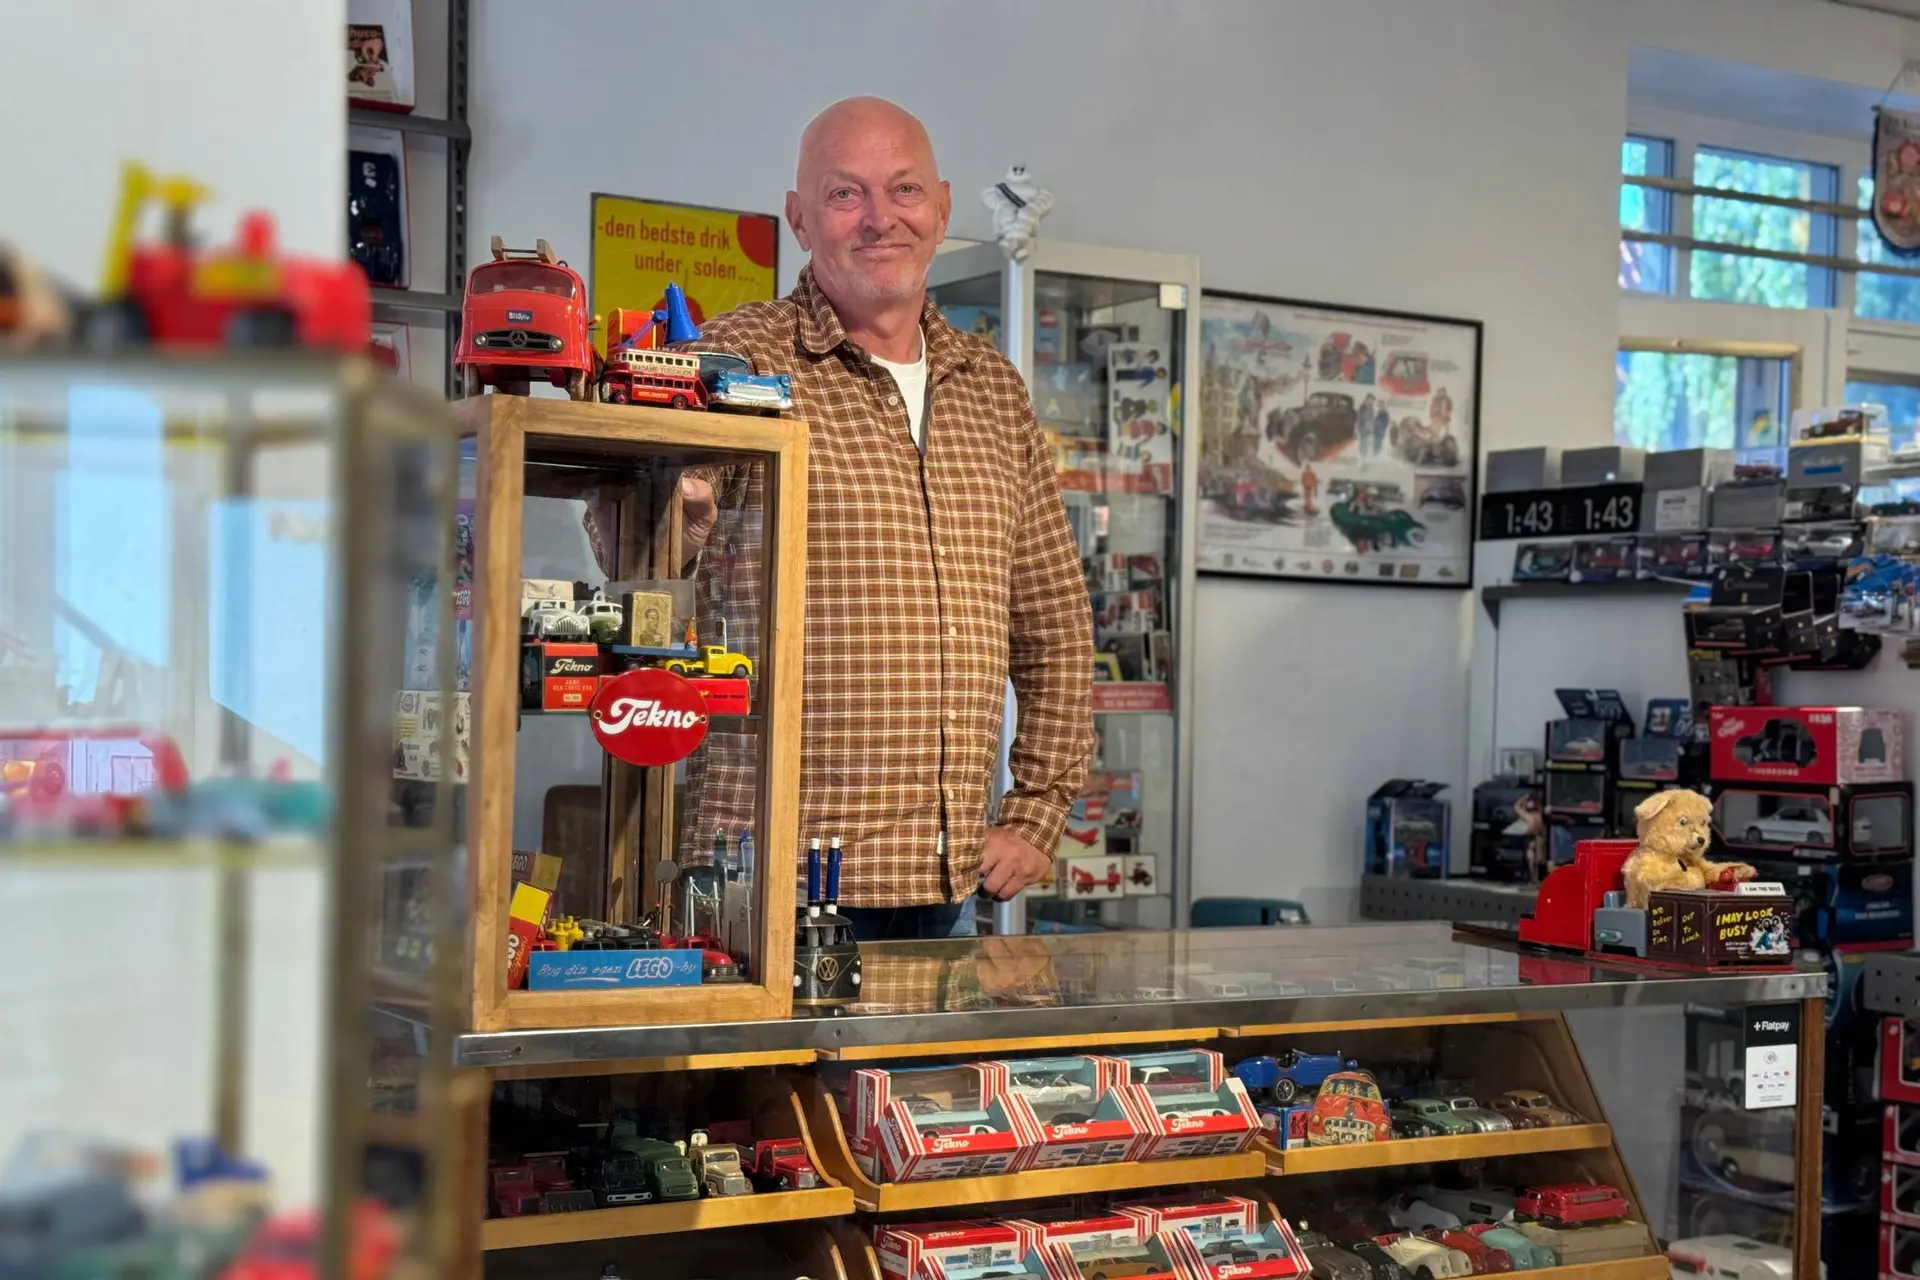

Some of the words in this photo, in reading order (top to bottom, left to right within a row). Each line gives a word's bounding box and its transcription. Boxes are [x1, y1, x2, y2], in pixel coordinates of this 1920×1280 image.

[349, 27, 382, 38] huco-
[598, 214, 635, 238] -den
[640, 218, 696, 246] bedste
[700, 226, 731, 250] drik
[635, 250, 682, 274] under
[1504, 500, 1553, 534] 1:43
[1583, 496, 1634, 530] 1:43
[550, 658, 594, 675] Tekno
[598, 697, 699, 735] Tekno
[512, 853, 528, 872] EGO
[1715, 914, 1721, 927] I
[1721, 912, 1744, 925] MAY
[1745, 907, 1774, 921] LOOK
[1719, 925, 1748, 940] BUSY
[564, 963, 588, 976] din
[592, 964, 623, 976] egen
[1761, 1021, 1790, 1032] Flatpay
[1052, 1123, 1089, 1139] Tekno
[1170, 1117, 1205, 1133] Tekno
[887, 1116, 904, 1151] Tekno
[931, 1137, 970, 1153] Tekno
[1217, 1265, 1253, 1280] Tekno
